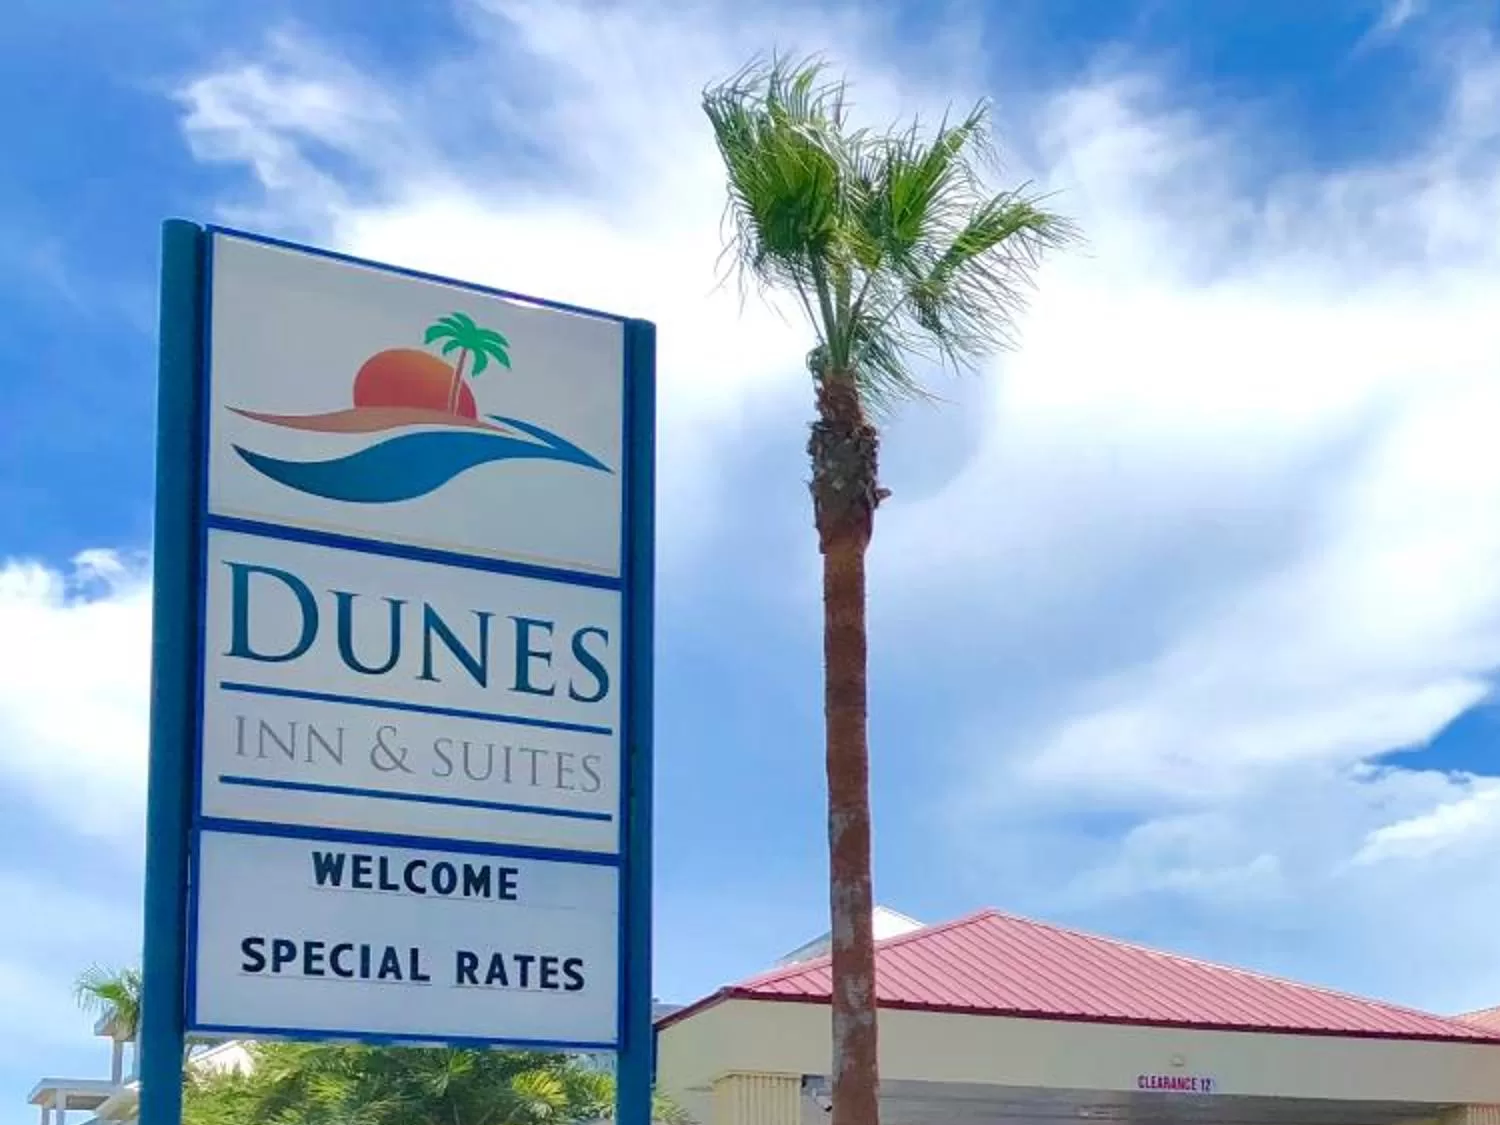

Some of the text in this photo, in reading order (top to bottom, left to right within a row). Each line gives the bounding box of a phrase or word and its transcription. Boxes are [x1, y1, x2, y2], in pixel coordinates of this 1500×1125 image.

[221, 559, 611, 703] DUNES
[235, 715, 602, 793] INN & SUITES
[311, 850, 520, 901] WELCOME
[240, 936, 585, 992] SPECIAL RATES
[1137, 1074, 1197, 1091] CLEARANCE
